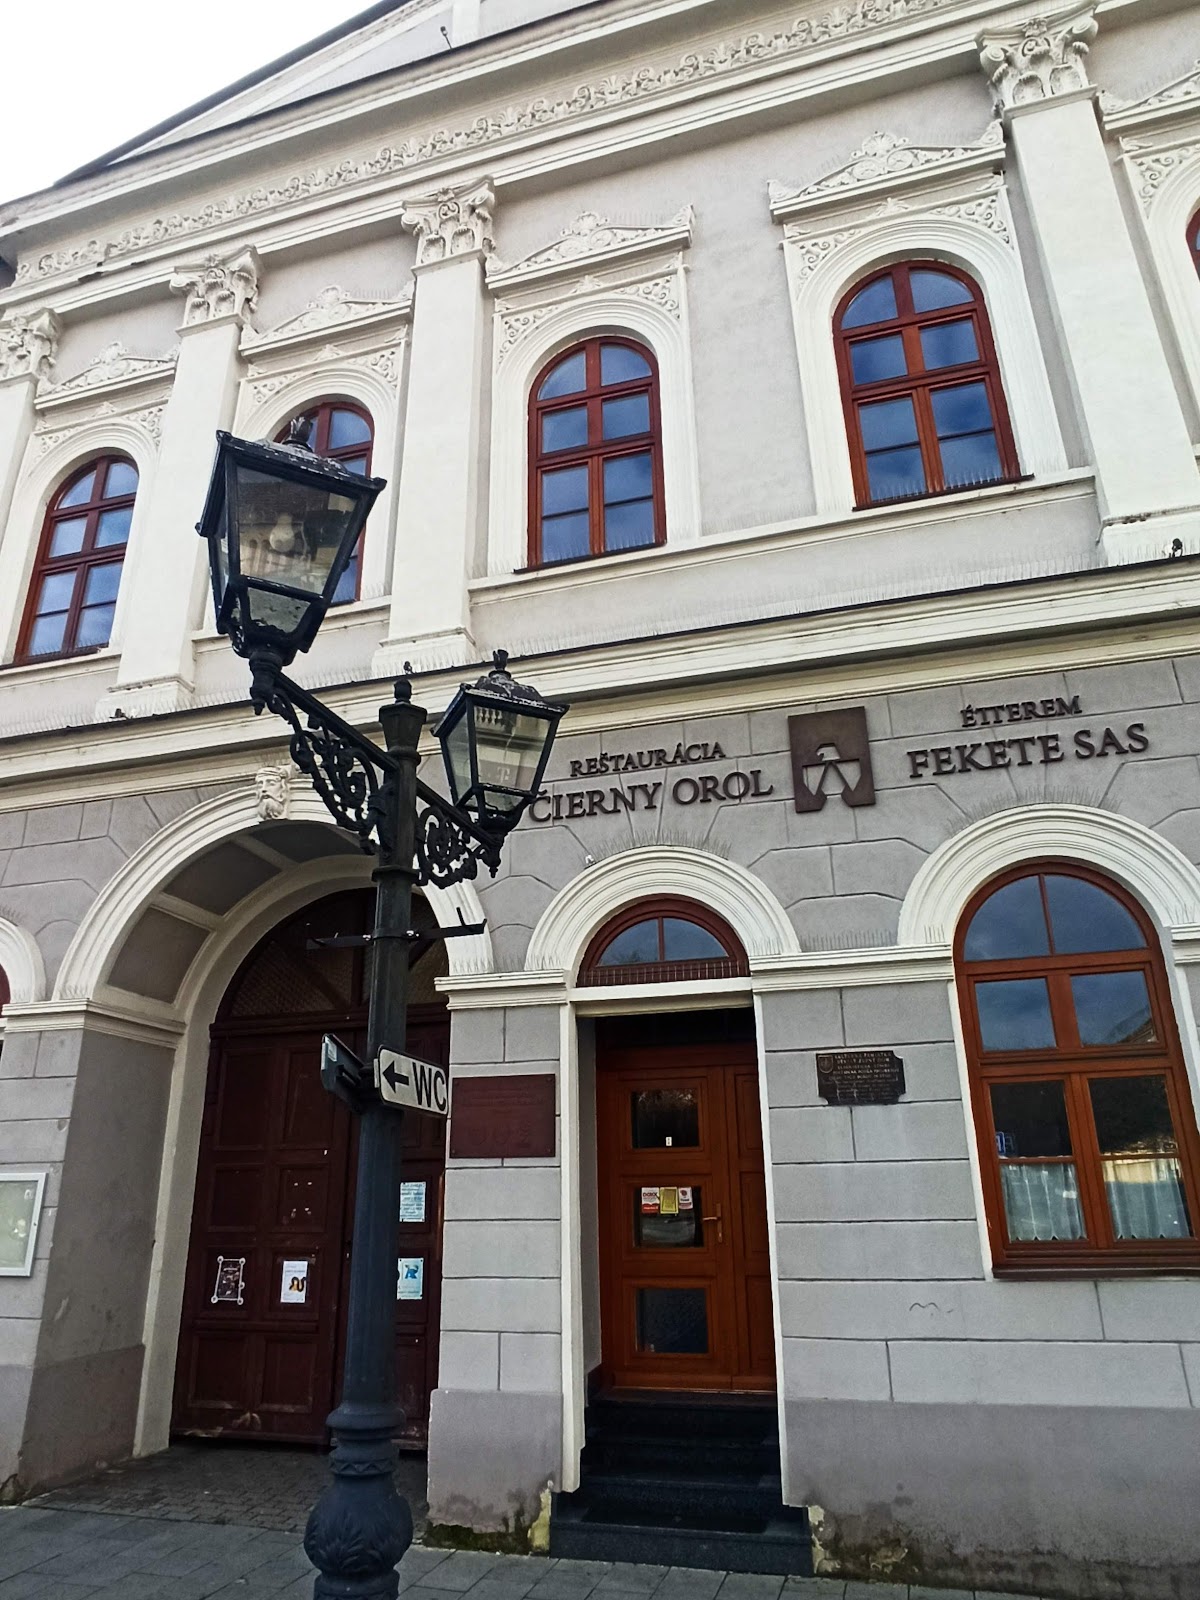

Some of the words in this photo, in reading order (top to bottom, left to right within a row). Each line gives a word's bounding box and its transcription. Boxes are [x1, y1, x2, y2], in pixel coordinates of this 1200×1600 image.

[961, 695, 1083, 728] ÉTTEREM
[569, 742, 726, 777] REŠTAURÁCIA
[907, 733, 1065, 778] FEKETE
[1073, 722, 1150, 760] SAS
[528, 782, 662, 822] ČIERNY
[672, 769, 774, 806] OROL
[412, 1062, 447, 1112] WC
